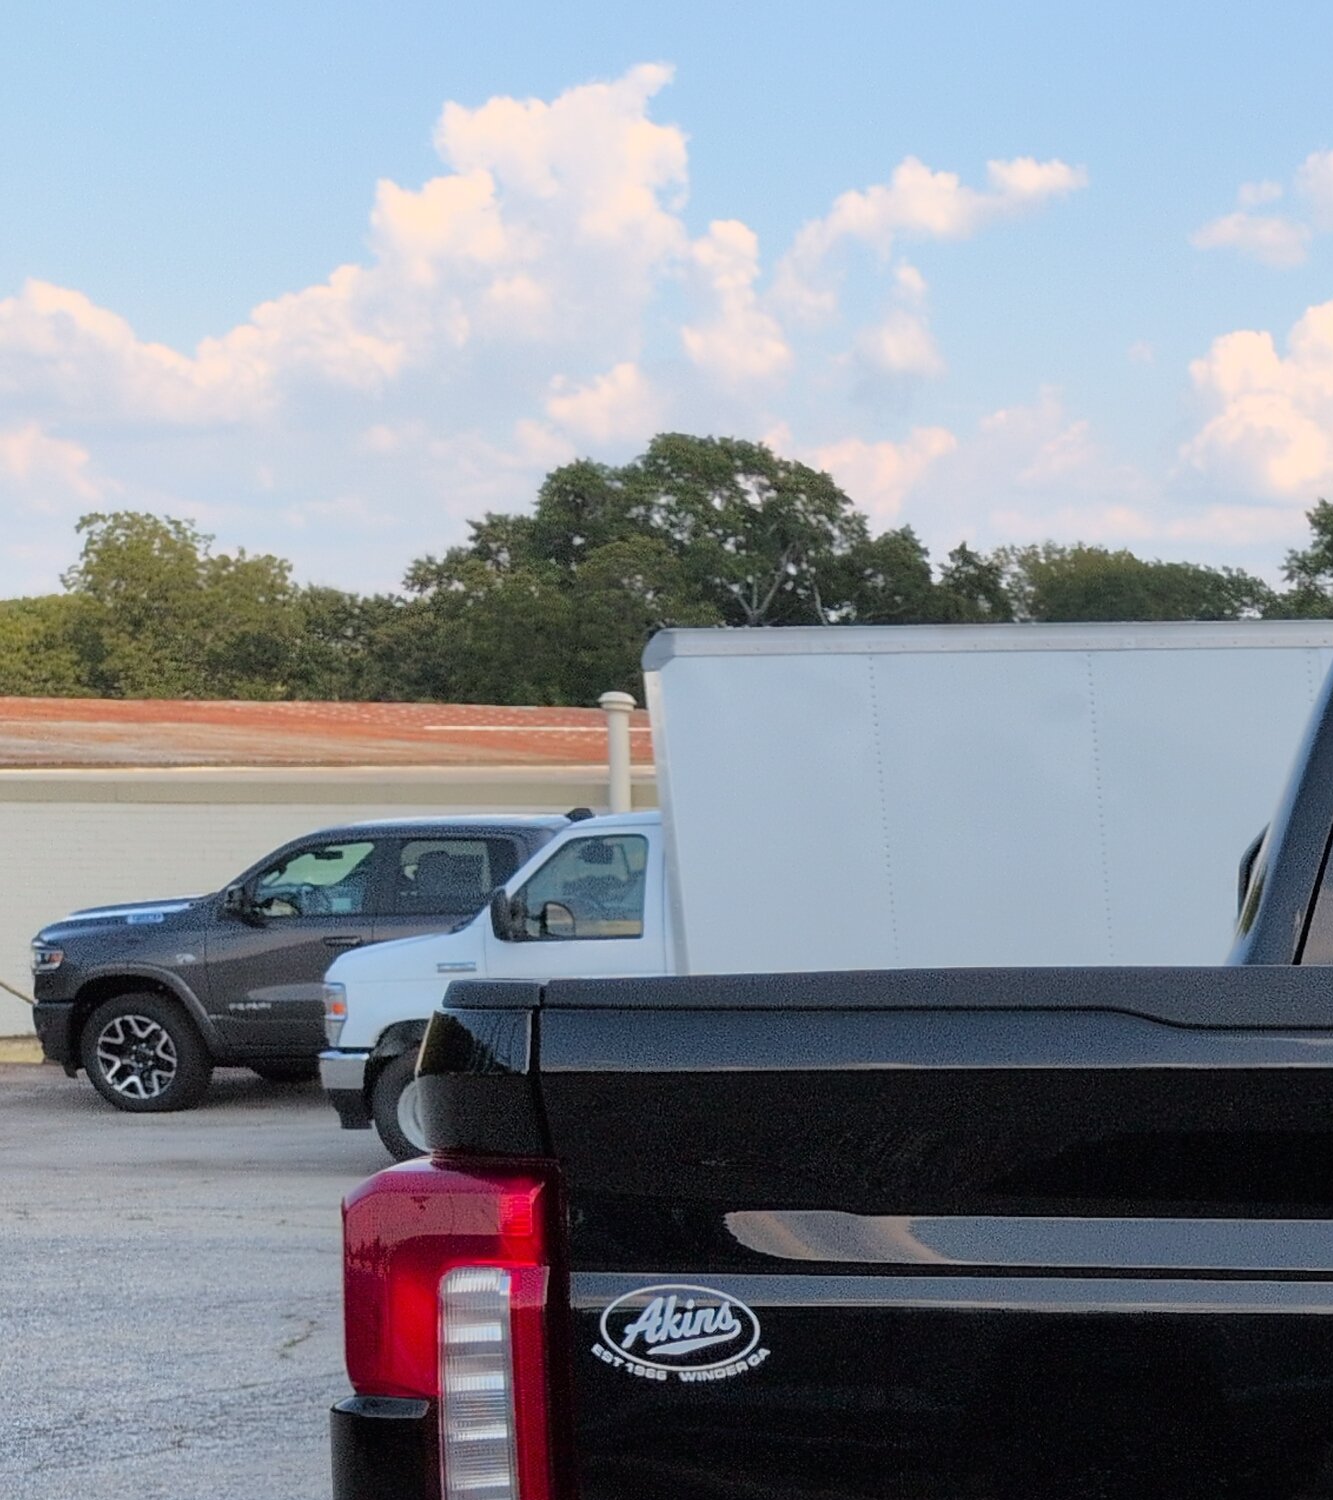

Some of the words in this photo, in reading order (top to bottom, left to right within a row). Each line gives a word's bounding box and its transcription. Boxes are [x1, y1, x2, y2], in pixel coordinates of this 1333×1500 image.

[621, 1295, 742, 1355] Akins
[678, 1361, 749, 1382] WINDER
[748, 1347, 772, 1368] GA
